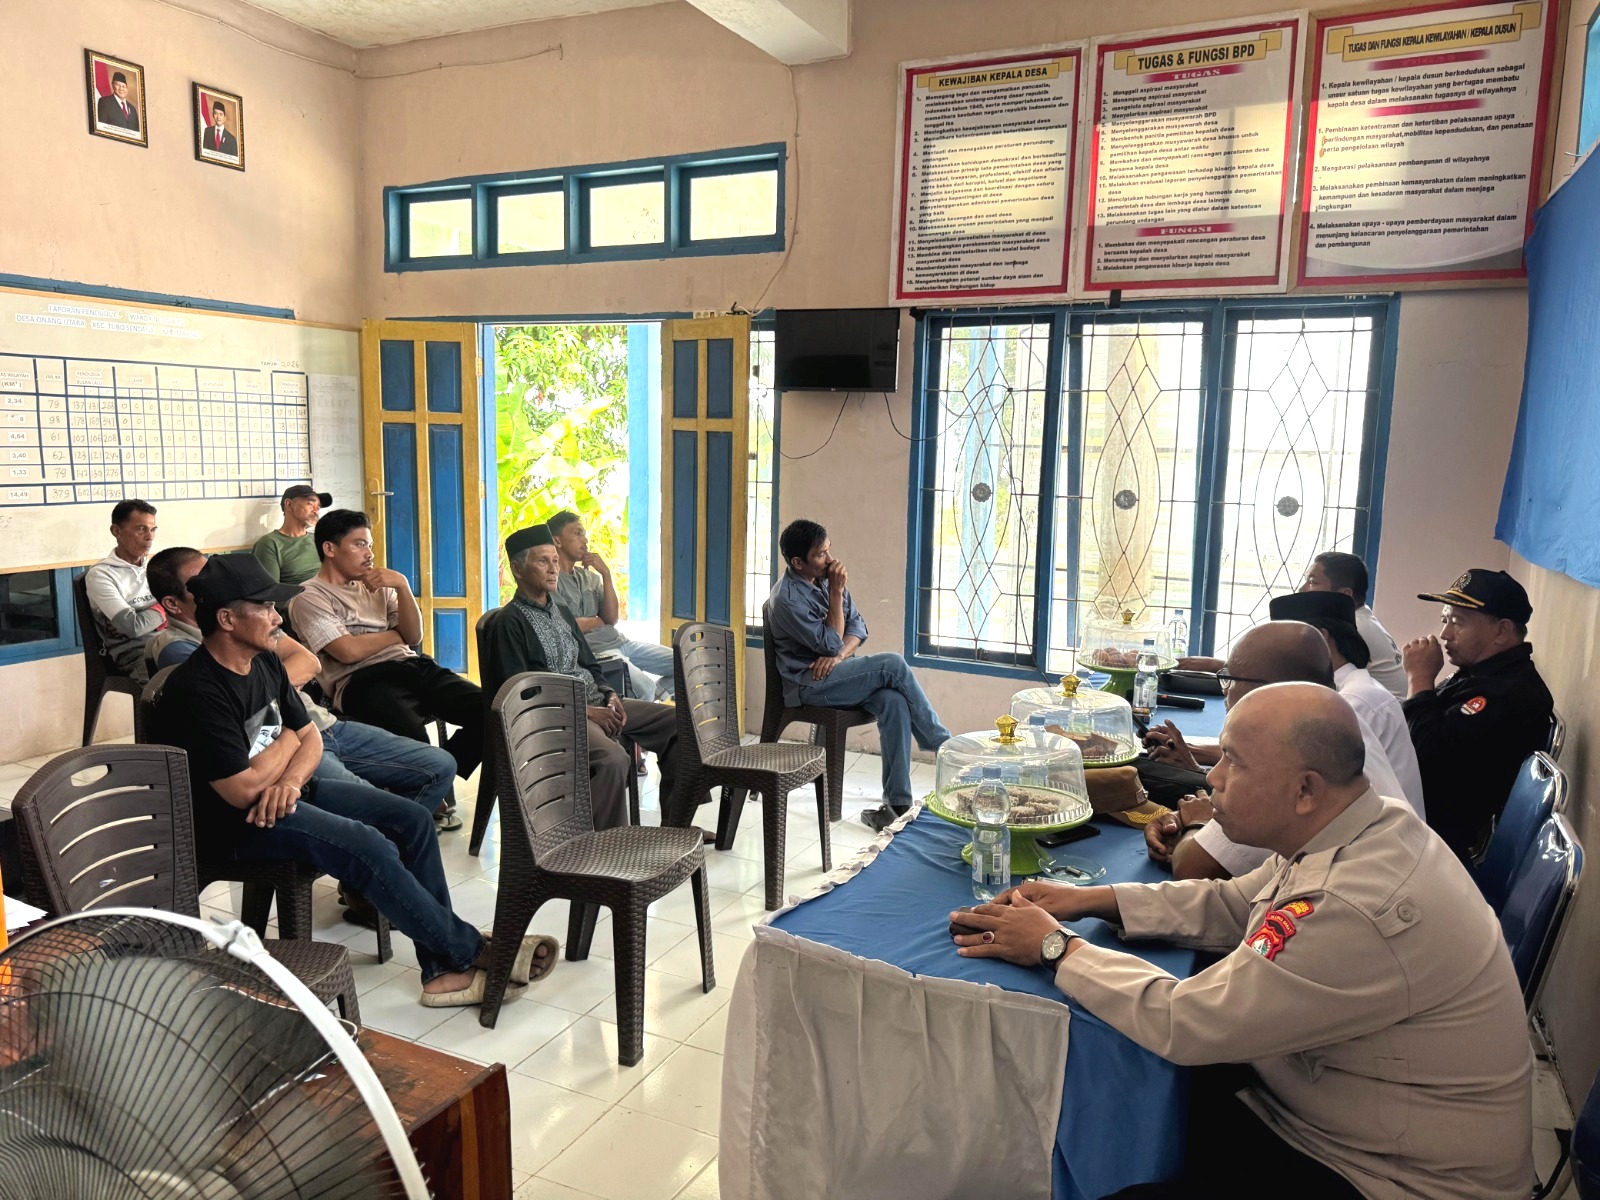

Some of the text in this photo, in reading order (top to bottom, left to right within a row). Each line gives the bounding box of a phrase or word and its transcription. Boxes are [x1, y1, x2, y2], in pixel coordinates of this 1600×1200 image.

[1348, 41, 1367, 53] TUGAS
[1367, 40, 1379, 50] DAN
[1380, 37, 1401, 49] FUNGSI
[1402, 34, 1424, 46] KEPALA
[1424, 28, 1466, 43] KEWILAYAHAN
[1469, 25, 1493, 38] KEPALA
[1494, 22, 1516, 35] DUSUN
[1137, 43, 1254, 70] TUGAS & FUNGSI BPD
[938, 67, 1047, 87] KEWAJIBAN KEPALA DESA
[1172, 69, 1220, 79] TUGAS
[1160, 226, 1212, 235] FUNGSI
[16, 314, 85, 326] DESA ONANG UTARA
[48, 400, 60, 409] 79
[49, 415, 60, 424] 98
[51, 433, 60, 441] 61
[52, 451, 65, 460] 62
